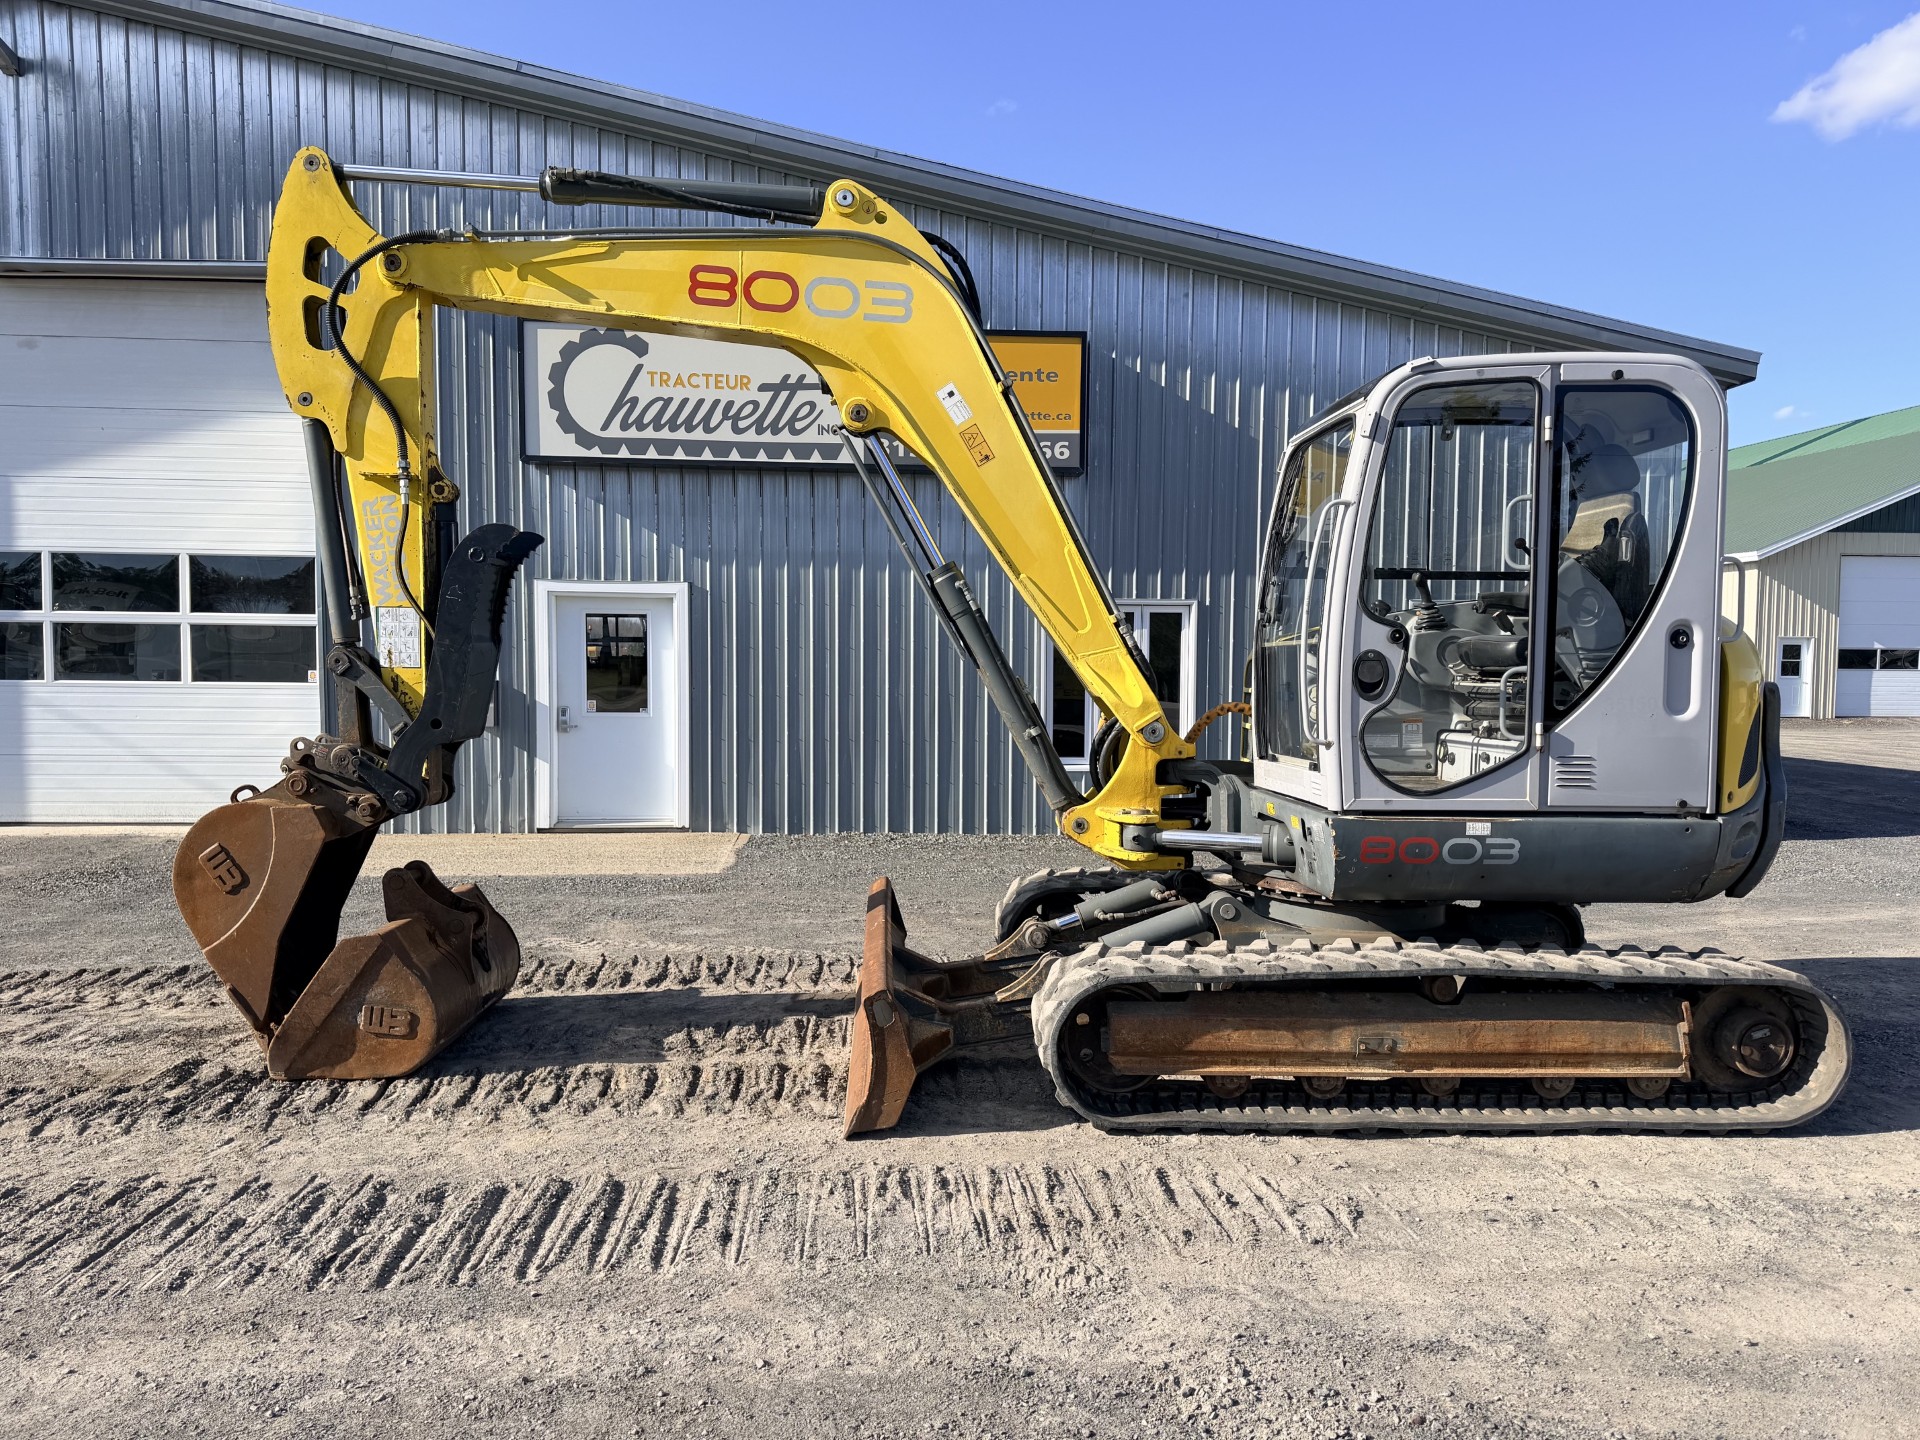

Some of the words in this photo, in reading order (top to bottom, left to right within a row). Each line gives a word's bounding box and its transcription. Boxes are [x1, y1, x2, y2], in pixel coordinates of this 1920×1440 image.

[688, 264, 914, 324] 8003
[647, 370, 752, 391] TRACTEUR
[1003, 367, 1059, 383] ente
[361, 496, 394, 607] WACKER
[1360, 836, 1521, 865] 8003
